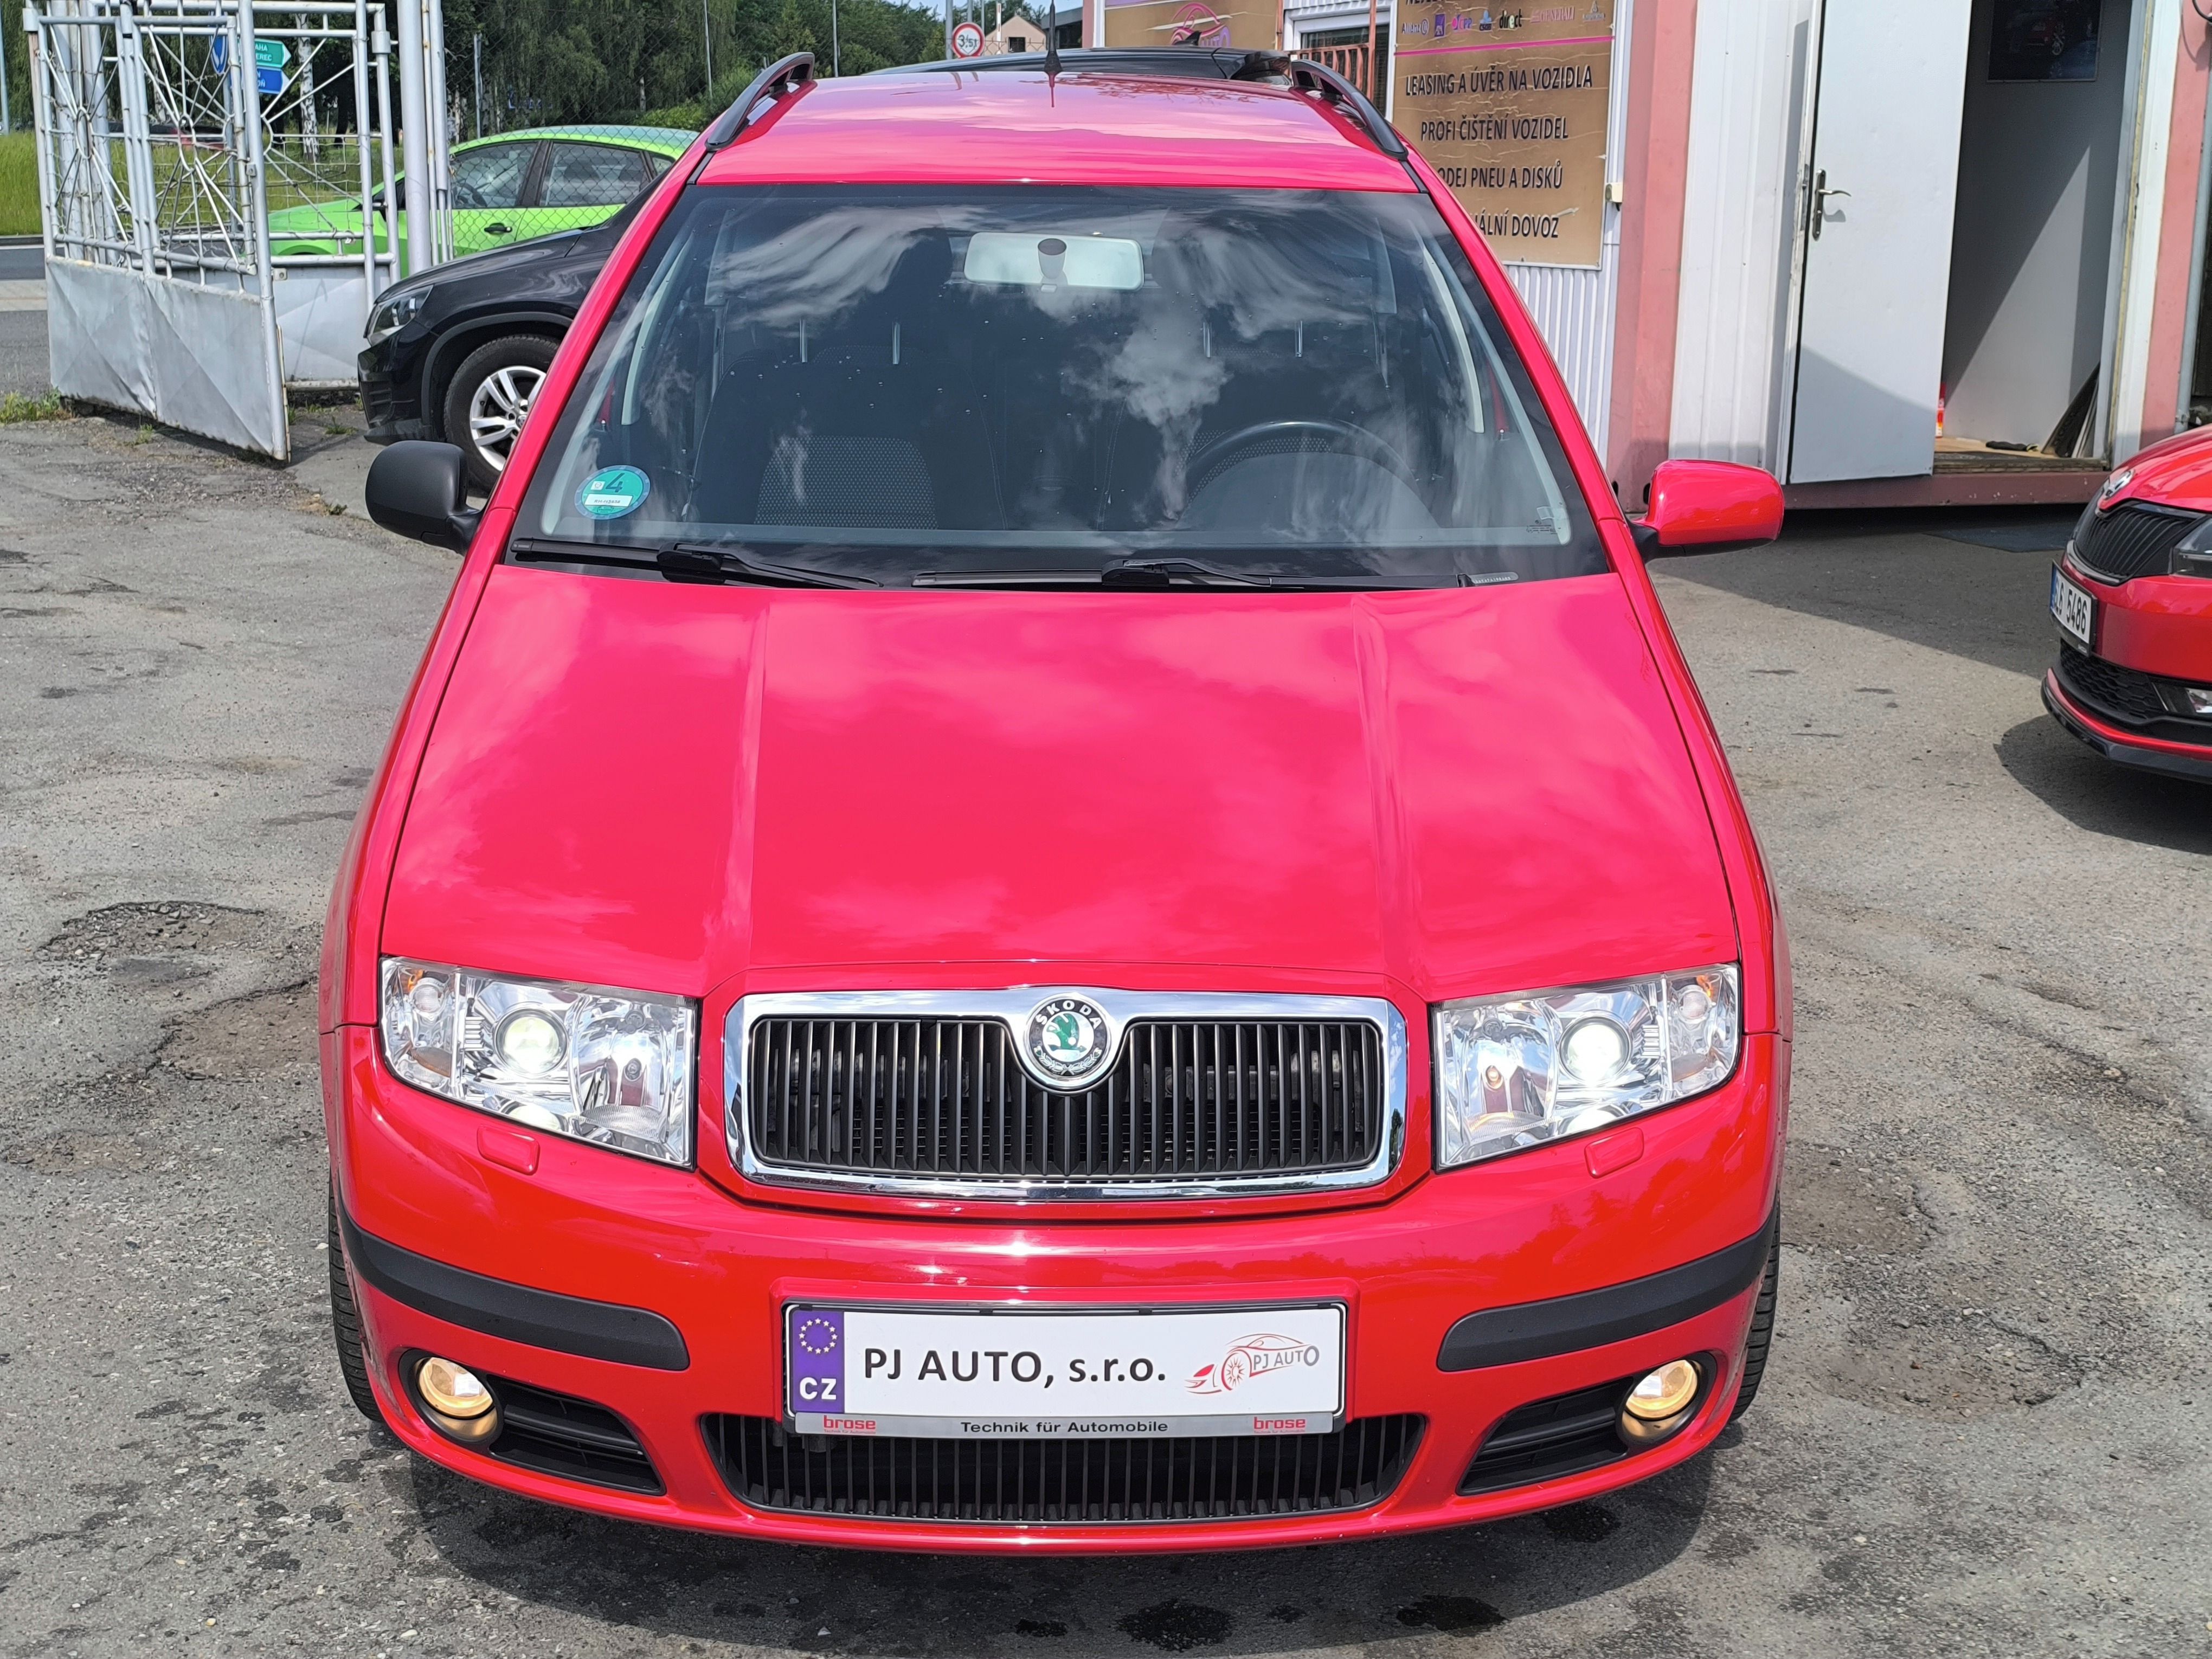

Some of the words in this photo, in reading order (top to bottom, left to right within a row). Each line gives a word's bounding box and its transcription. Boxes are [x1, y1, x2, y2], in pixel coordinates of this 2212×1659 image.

[1499, 9, 1522, 29] direct
[255, 43, 268, 52] AHA
[1406, 74, 1455, 96] LEASING
[1458, 73, 1466, 93] A
[1470, 65, 1504, 93] ÚVĚR
[1509, 70, 1528, 91] NA
[1532, 66, 1592, 89] VOZIDLA
[1421, 121, 1456, 141] PROFI
[1459, 114, 1508, 140] ČIŠTĚNÍ
[1512, 117, 1568, 139] VOZIDEL
[1438, 168, 1467, 187] ODEJ
[1471, 168, 1505, 188] PNEU
[1509, 168, 1517, 188] A
[1522, 160, 1562, 189] DISKŮ
[1512, 216, 1559, 238] DOVOZ
[605, 473, 625, 492] 4
[2067, 588, 2087, 635] 5486
[865, 1348, 901, 1379] PJ
[918, 1351, 1053, 1388] AUTO,
[1069, 1358, 1166, 1382] s.r.o.
[1253, 1354, 1269, 1370] PJ
[1274, 1346, 1320, 1366] AUTO
[800, 1377, 837, 1400] CZ
[824, 1415, 876, 1430] brose
[961, 1422, 1029, 1433] Technik
[1036, 1422, 1060, 1432] für
[1068, 1422, 1168, 1432] Automobile
[1254, 1417, 1306, 1429] brose
